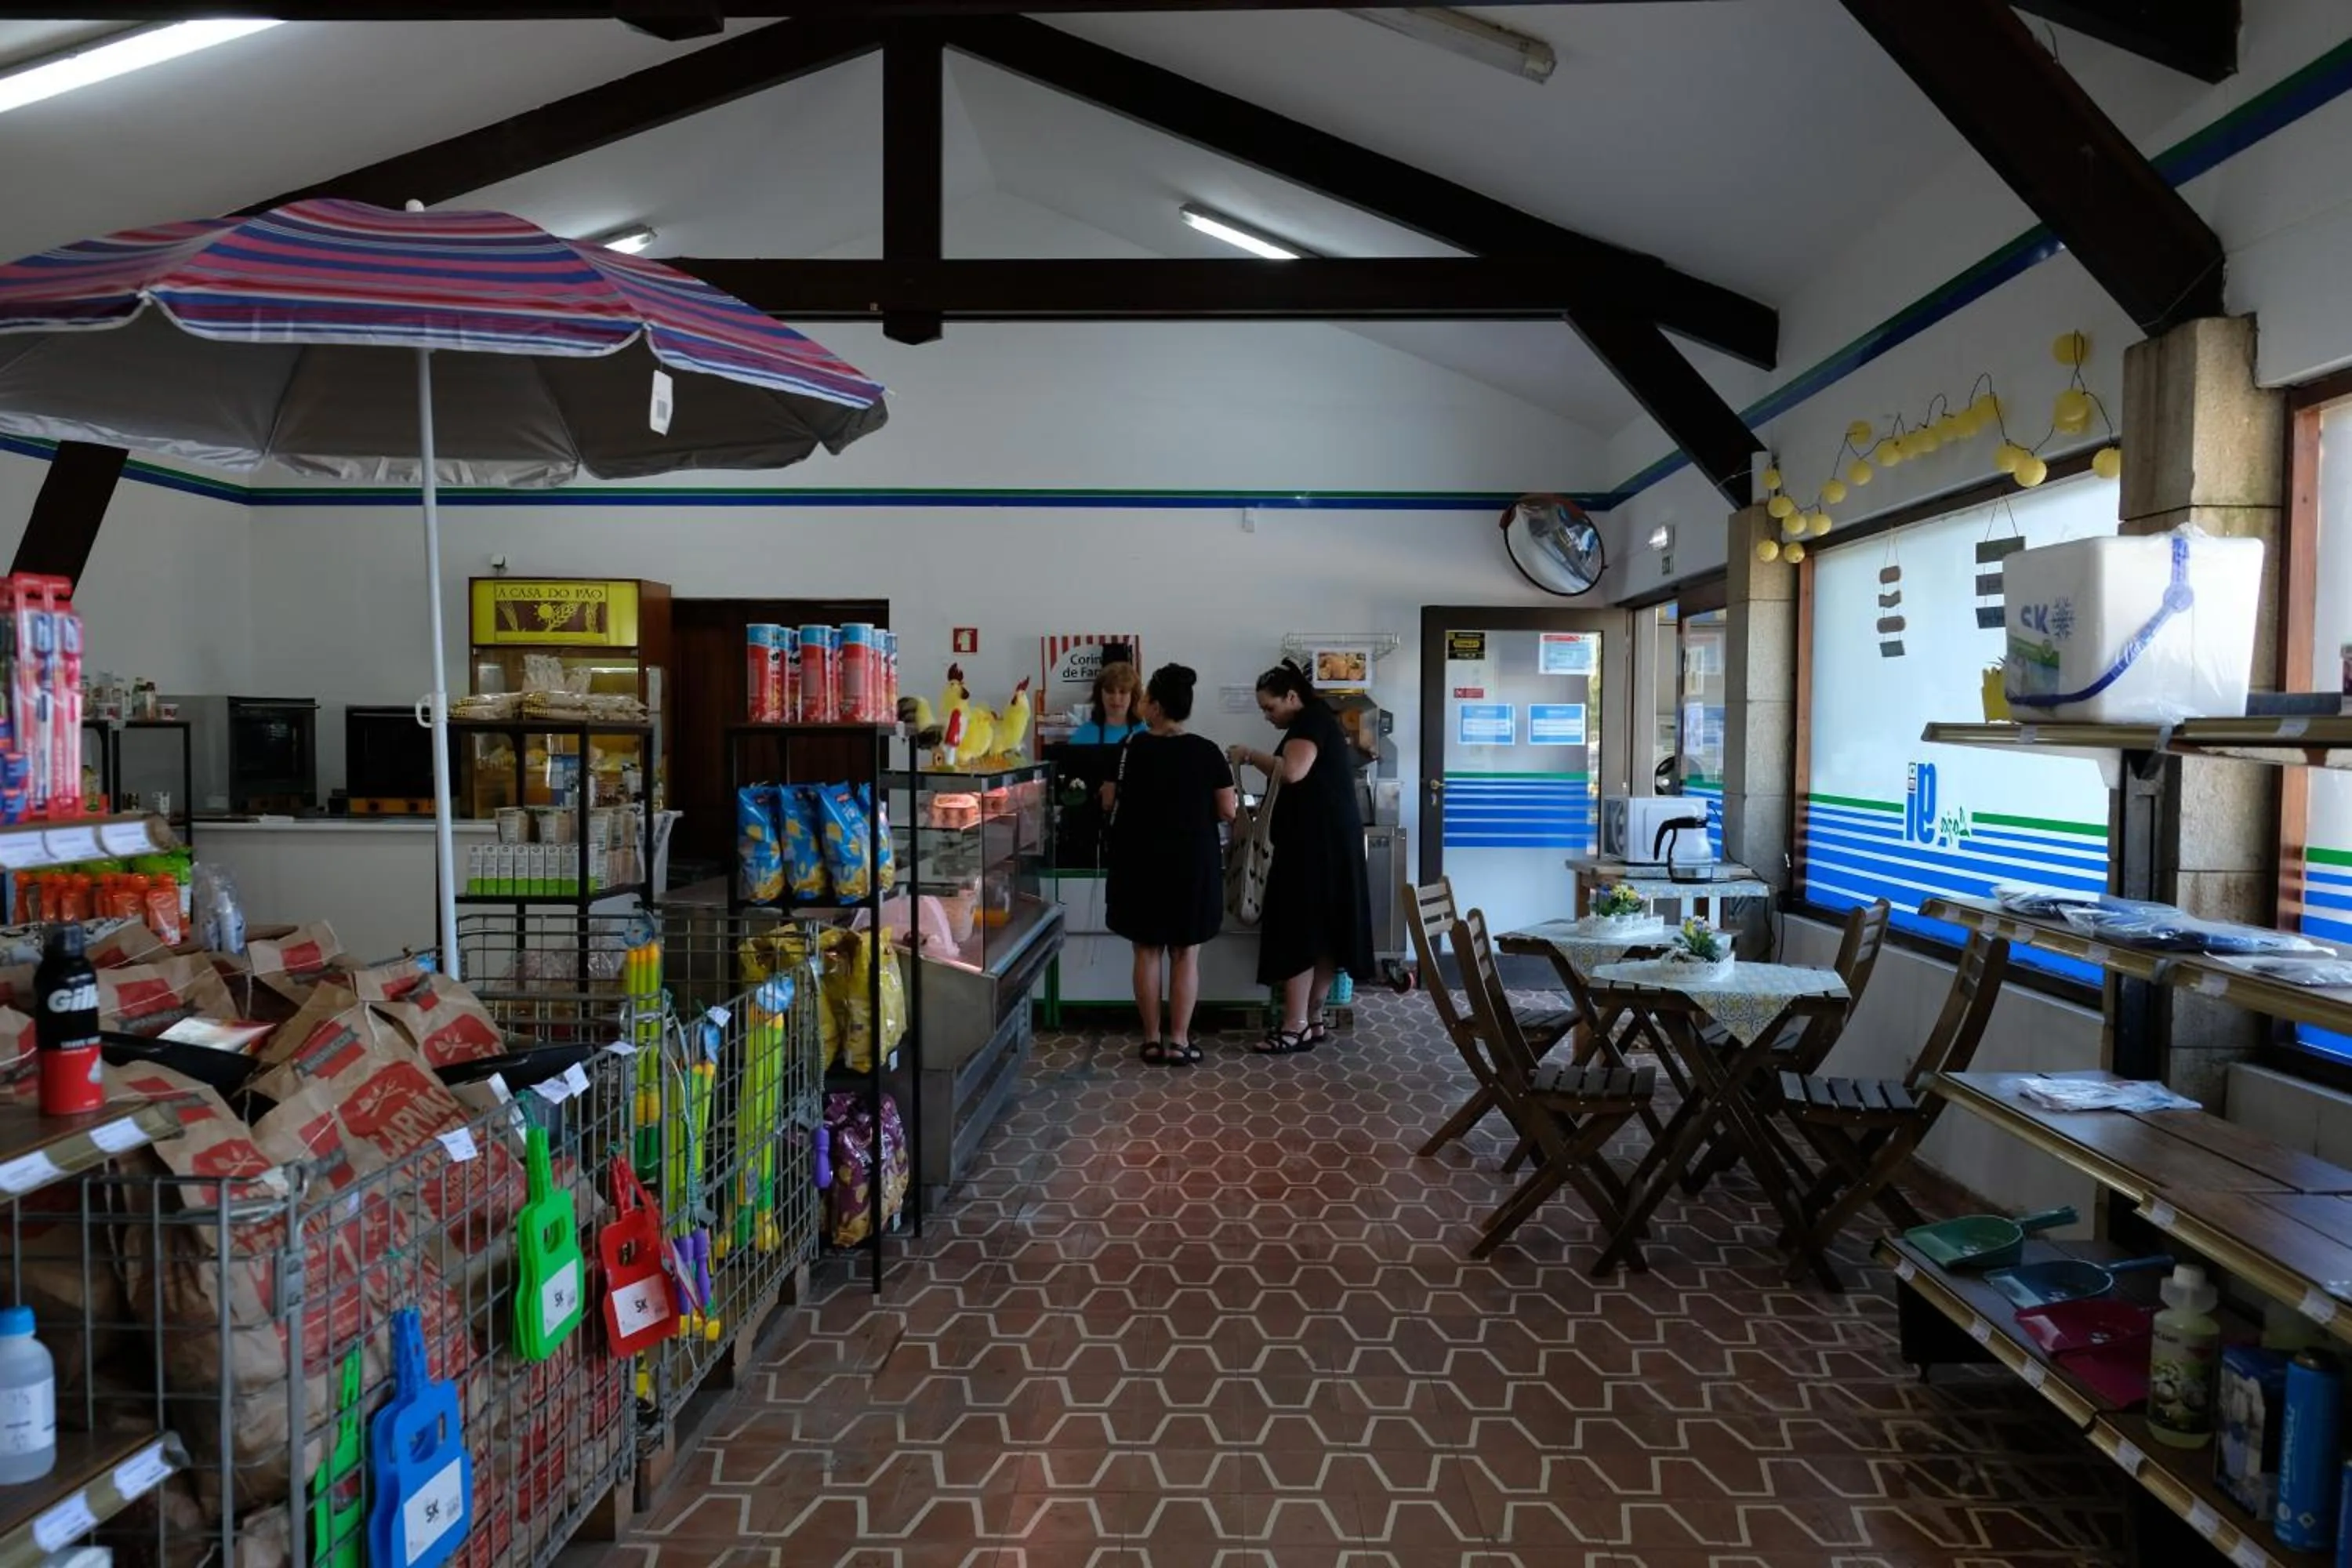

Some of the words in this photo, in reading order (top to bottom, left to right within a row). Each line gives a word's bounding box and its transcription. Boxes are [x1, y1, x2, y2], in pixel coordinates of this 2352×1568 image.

[498, 588, 506, 597] A
[510, 588, 542, 598] CASA
[548, 588, 570, 598] DO
[1062, 667, 1077, 678] de
